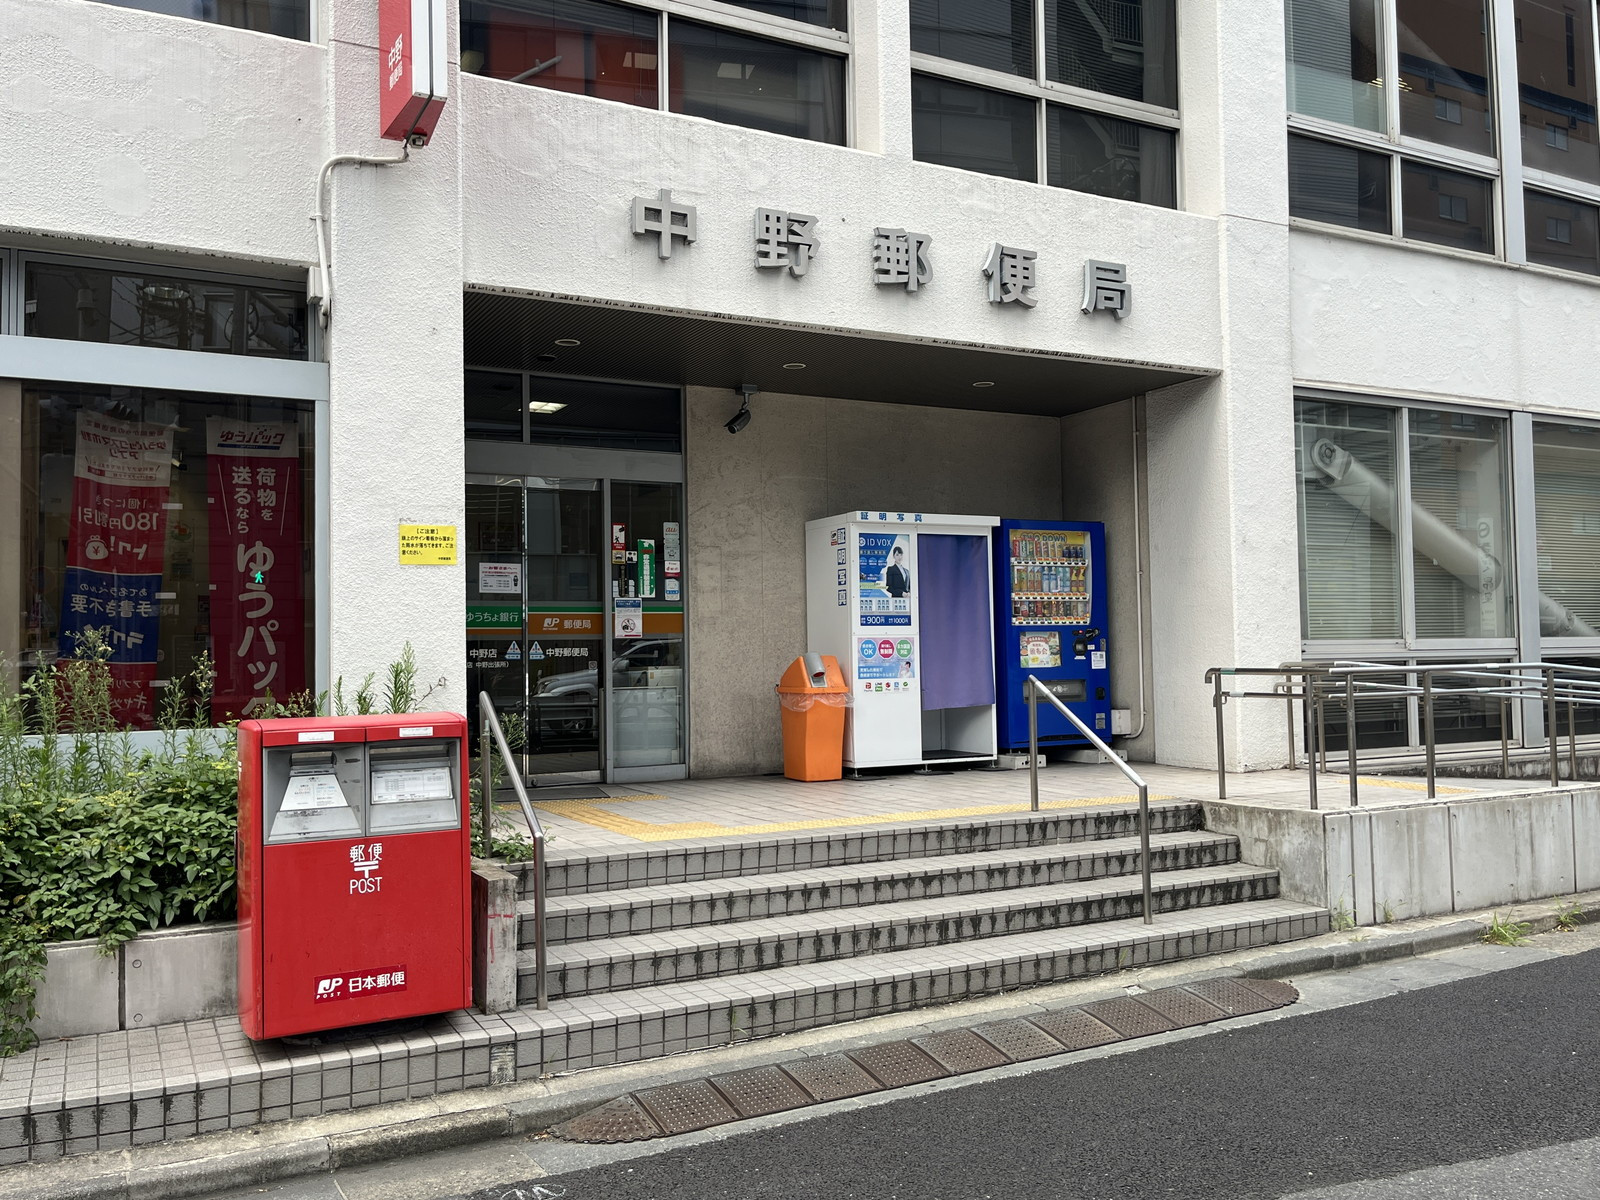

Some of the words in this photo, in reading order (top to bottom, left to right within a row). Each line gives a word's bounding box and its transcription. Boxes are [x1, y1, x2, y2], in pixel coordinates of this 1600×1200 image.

[632, 188, 1132, 320] 中野郵便局
[220, 429, 285, 445] ゆうパック
[231, 466, 253, 534] 送るなら
[256, 467, 277, 521] 荷物を
[861, 512, 922, 522] 証明写真
[877, 539, 892, 547] VOX
[837, 528, 847, 606] 証明写真
[466, 612, 519, 622] ゆうちょ銀行
[563, 620, 591, 629] 郵便局
[469, 649, 498, 658] 中野店
[546, 648, 589, 657] 中野郵便局
[349, 843, 383, 863] 郵便
[349, 877, 383, 894] POST
[317, 978, 343, 994] JP
[348, 971, 405, 993] 日本郵便
